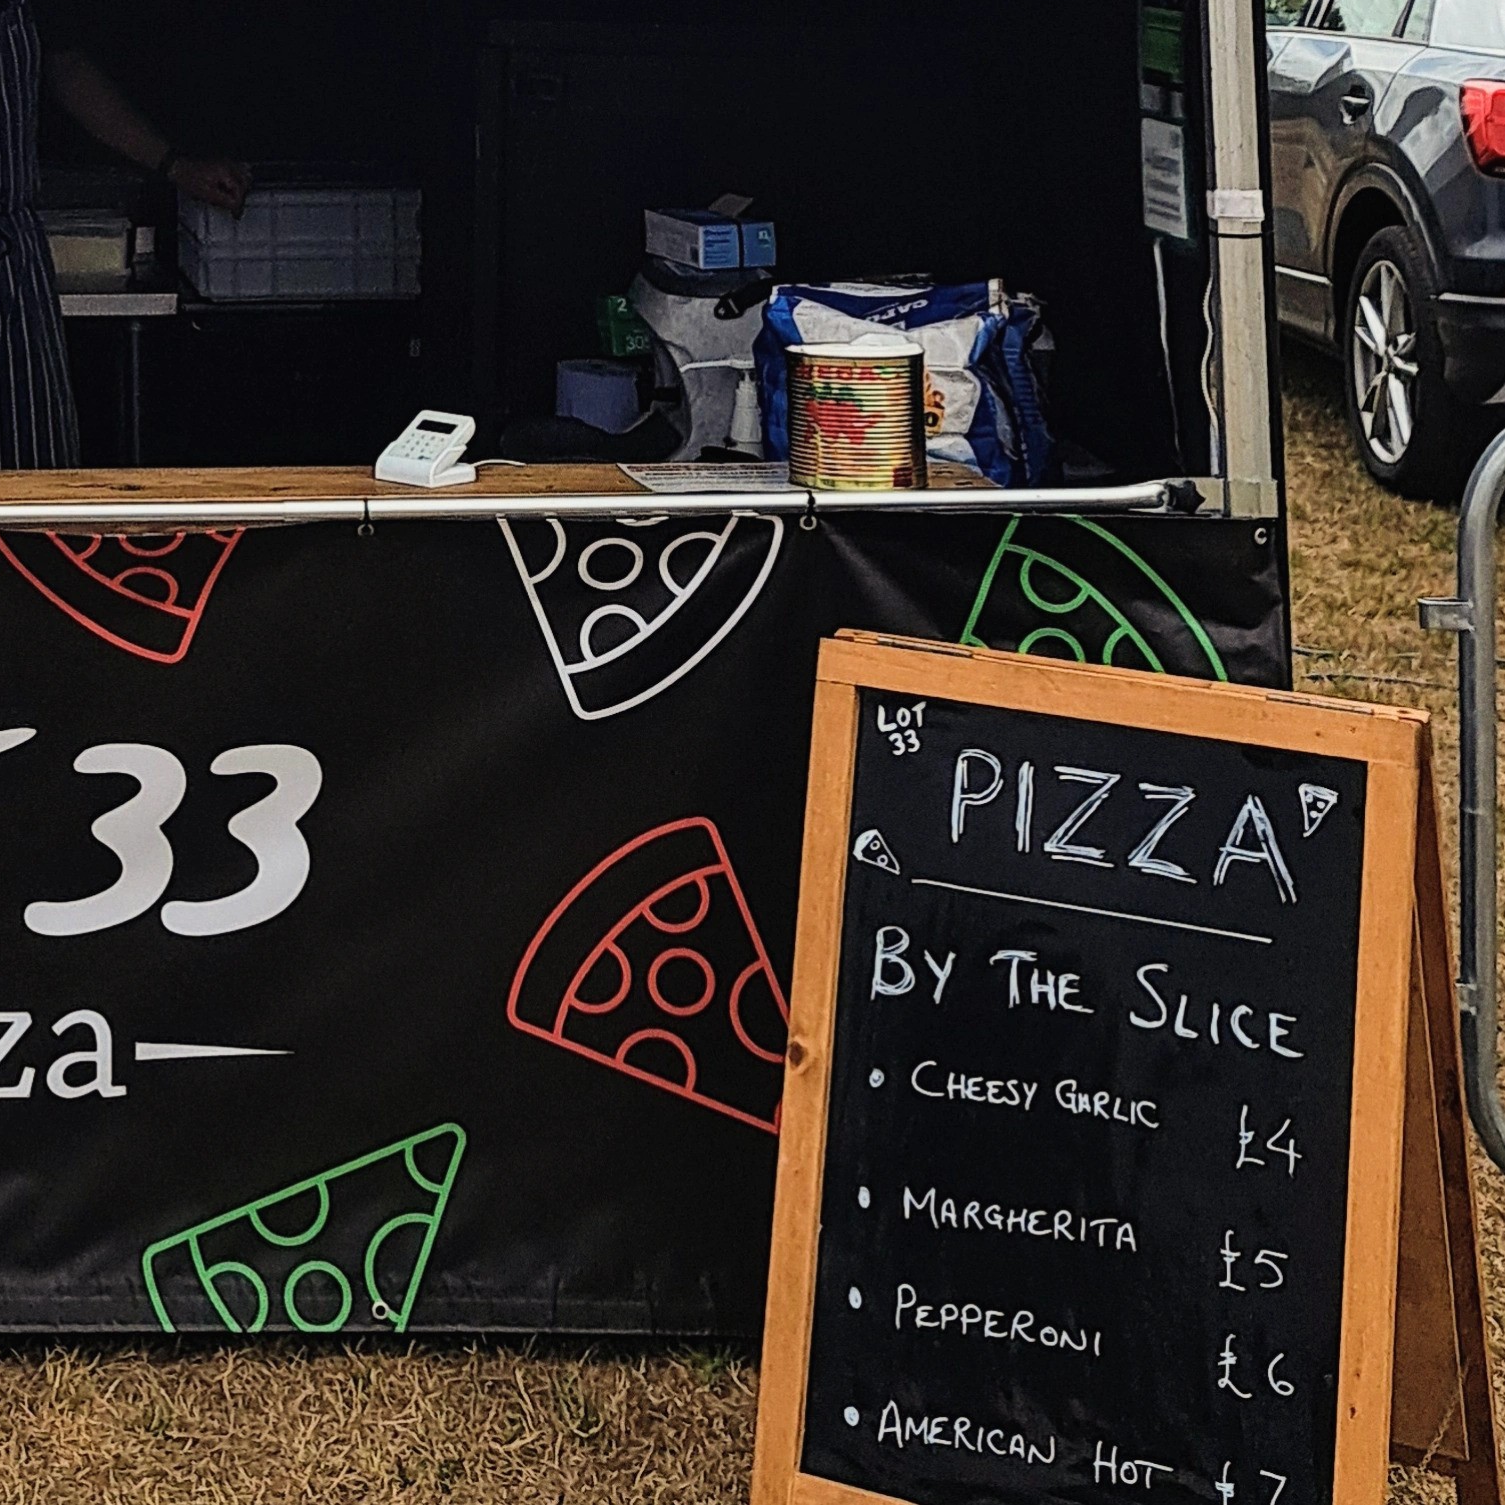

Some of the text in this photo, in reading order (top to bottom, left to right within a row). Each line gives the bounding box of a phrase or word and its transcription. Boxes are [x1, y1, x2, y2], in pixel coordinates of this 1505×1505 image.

[878, 702, 926, 733] LOT
[888, 730, 921, 756] 33
[23, 743, 323, 937] 33
[949, 748, 1297, 903] PIZZA
[990, 949, 1095, 1016] THE
[1129, 963, 1305, 1059] SLICE
[910, 1061, 1304, 1177] CHEESY GARLIC £4
[902, 1185, 1288, 1292] MARGHERITA £5
[895, 1283, 1102, 1358] PEPPERONI
[877, 1399, 1057, 1467] AMERICAN
[1093, 1440, 1175, 1493] HOT
